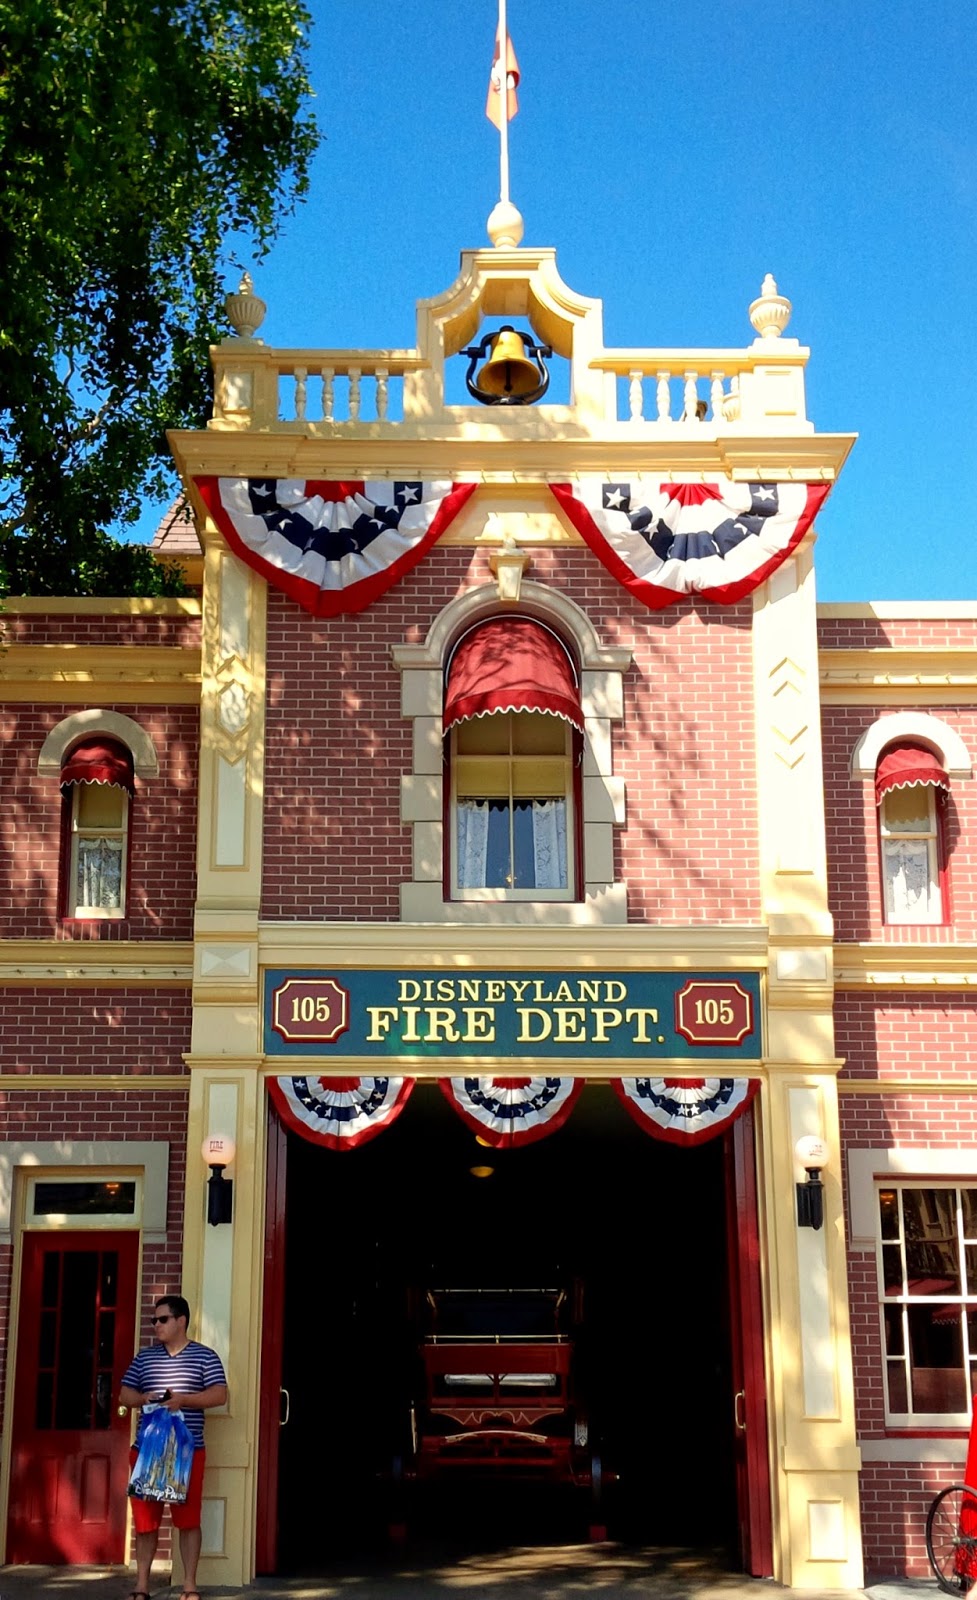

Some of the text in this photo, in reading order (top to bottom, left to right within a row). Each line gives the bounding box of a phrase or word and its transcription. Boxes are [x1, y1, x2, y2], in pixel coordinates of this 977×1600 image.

[398, 979, 627, 1003] DISNEYLAND
[290, 996, 330, 1022] 105
[694, 998, 735, 1025] 105
[365, 1006, 664, 1043] FIRE DEPT.
